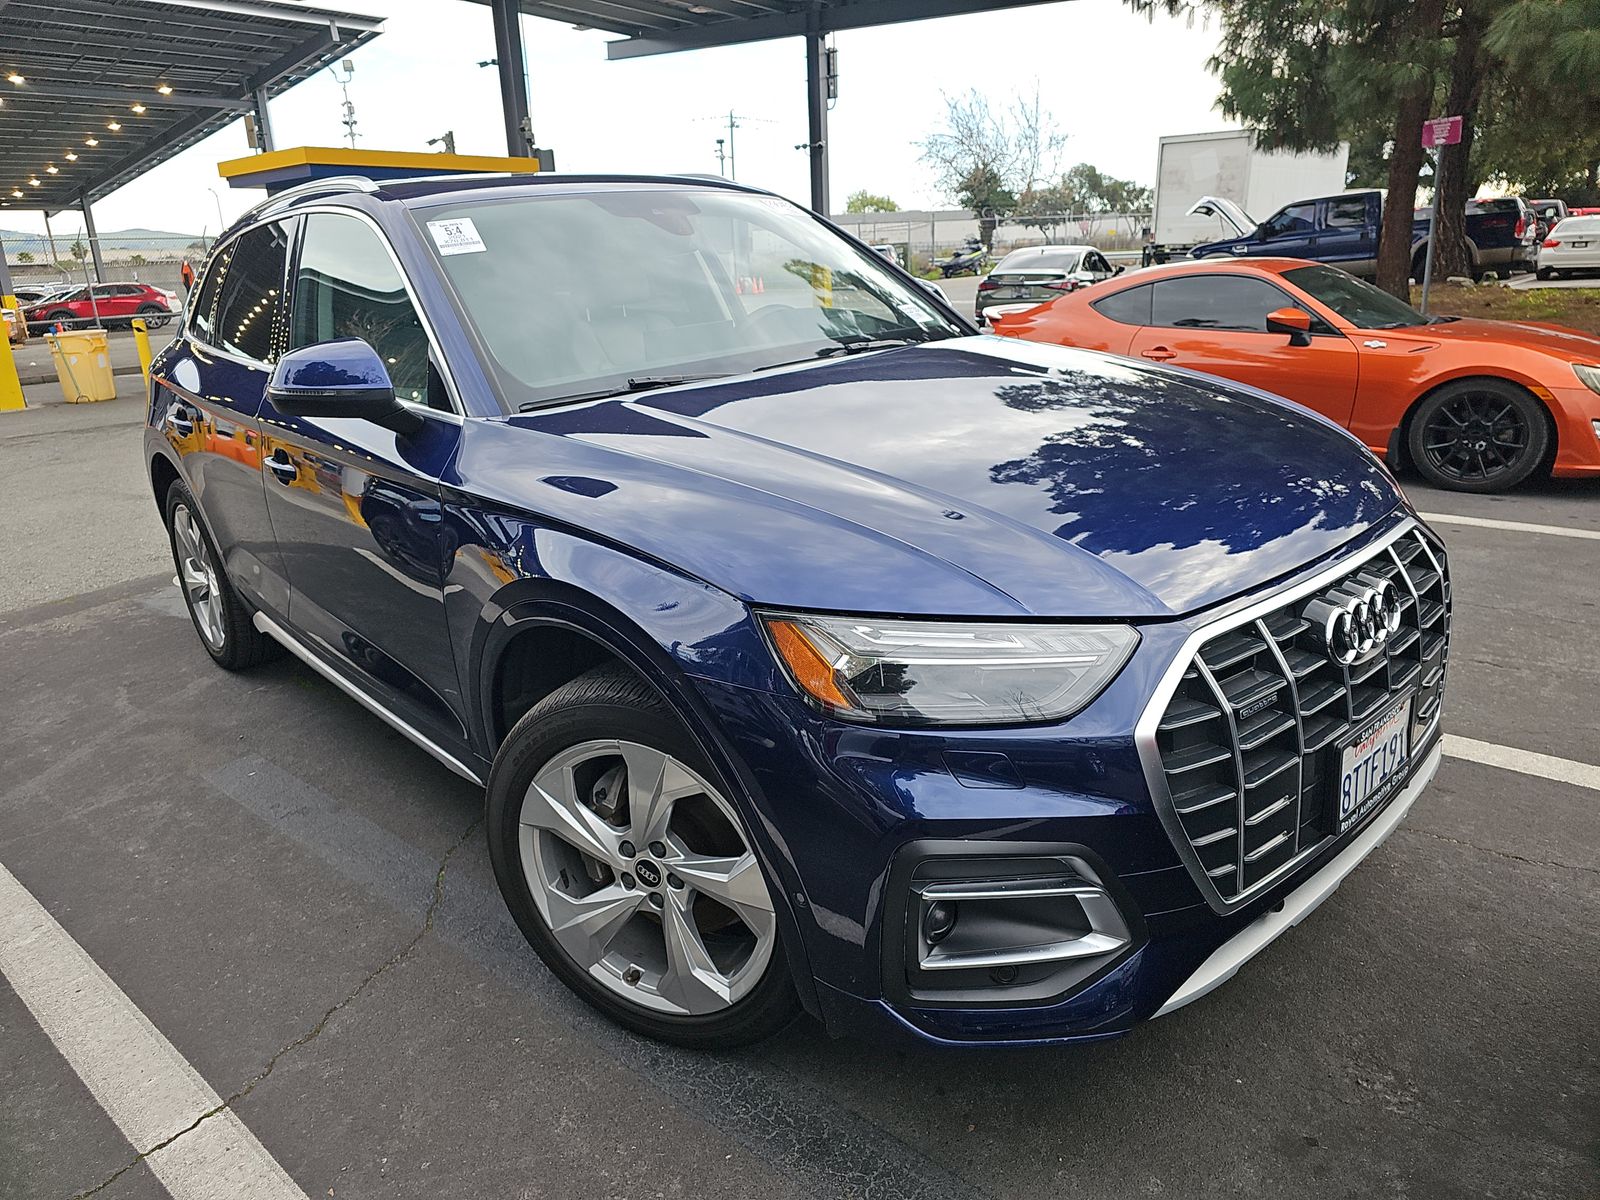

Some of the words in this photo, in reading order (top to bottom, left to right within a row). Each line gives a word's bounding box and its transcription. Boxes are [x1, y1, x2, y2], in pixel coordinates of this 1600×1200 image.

[1242, 694, 1278, 717] quattro
[1360, 724, 1374, 742] SAN
[1374, 703, 1402, 732] FRANCISCO
[1342, 725, 1406, 814] 8TTF191
[1340, 808, 1359, 833] Royal
[1359, 782, 1392, 817] Automotive
[1391, 765, 1409, 786] Group
